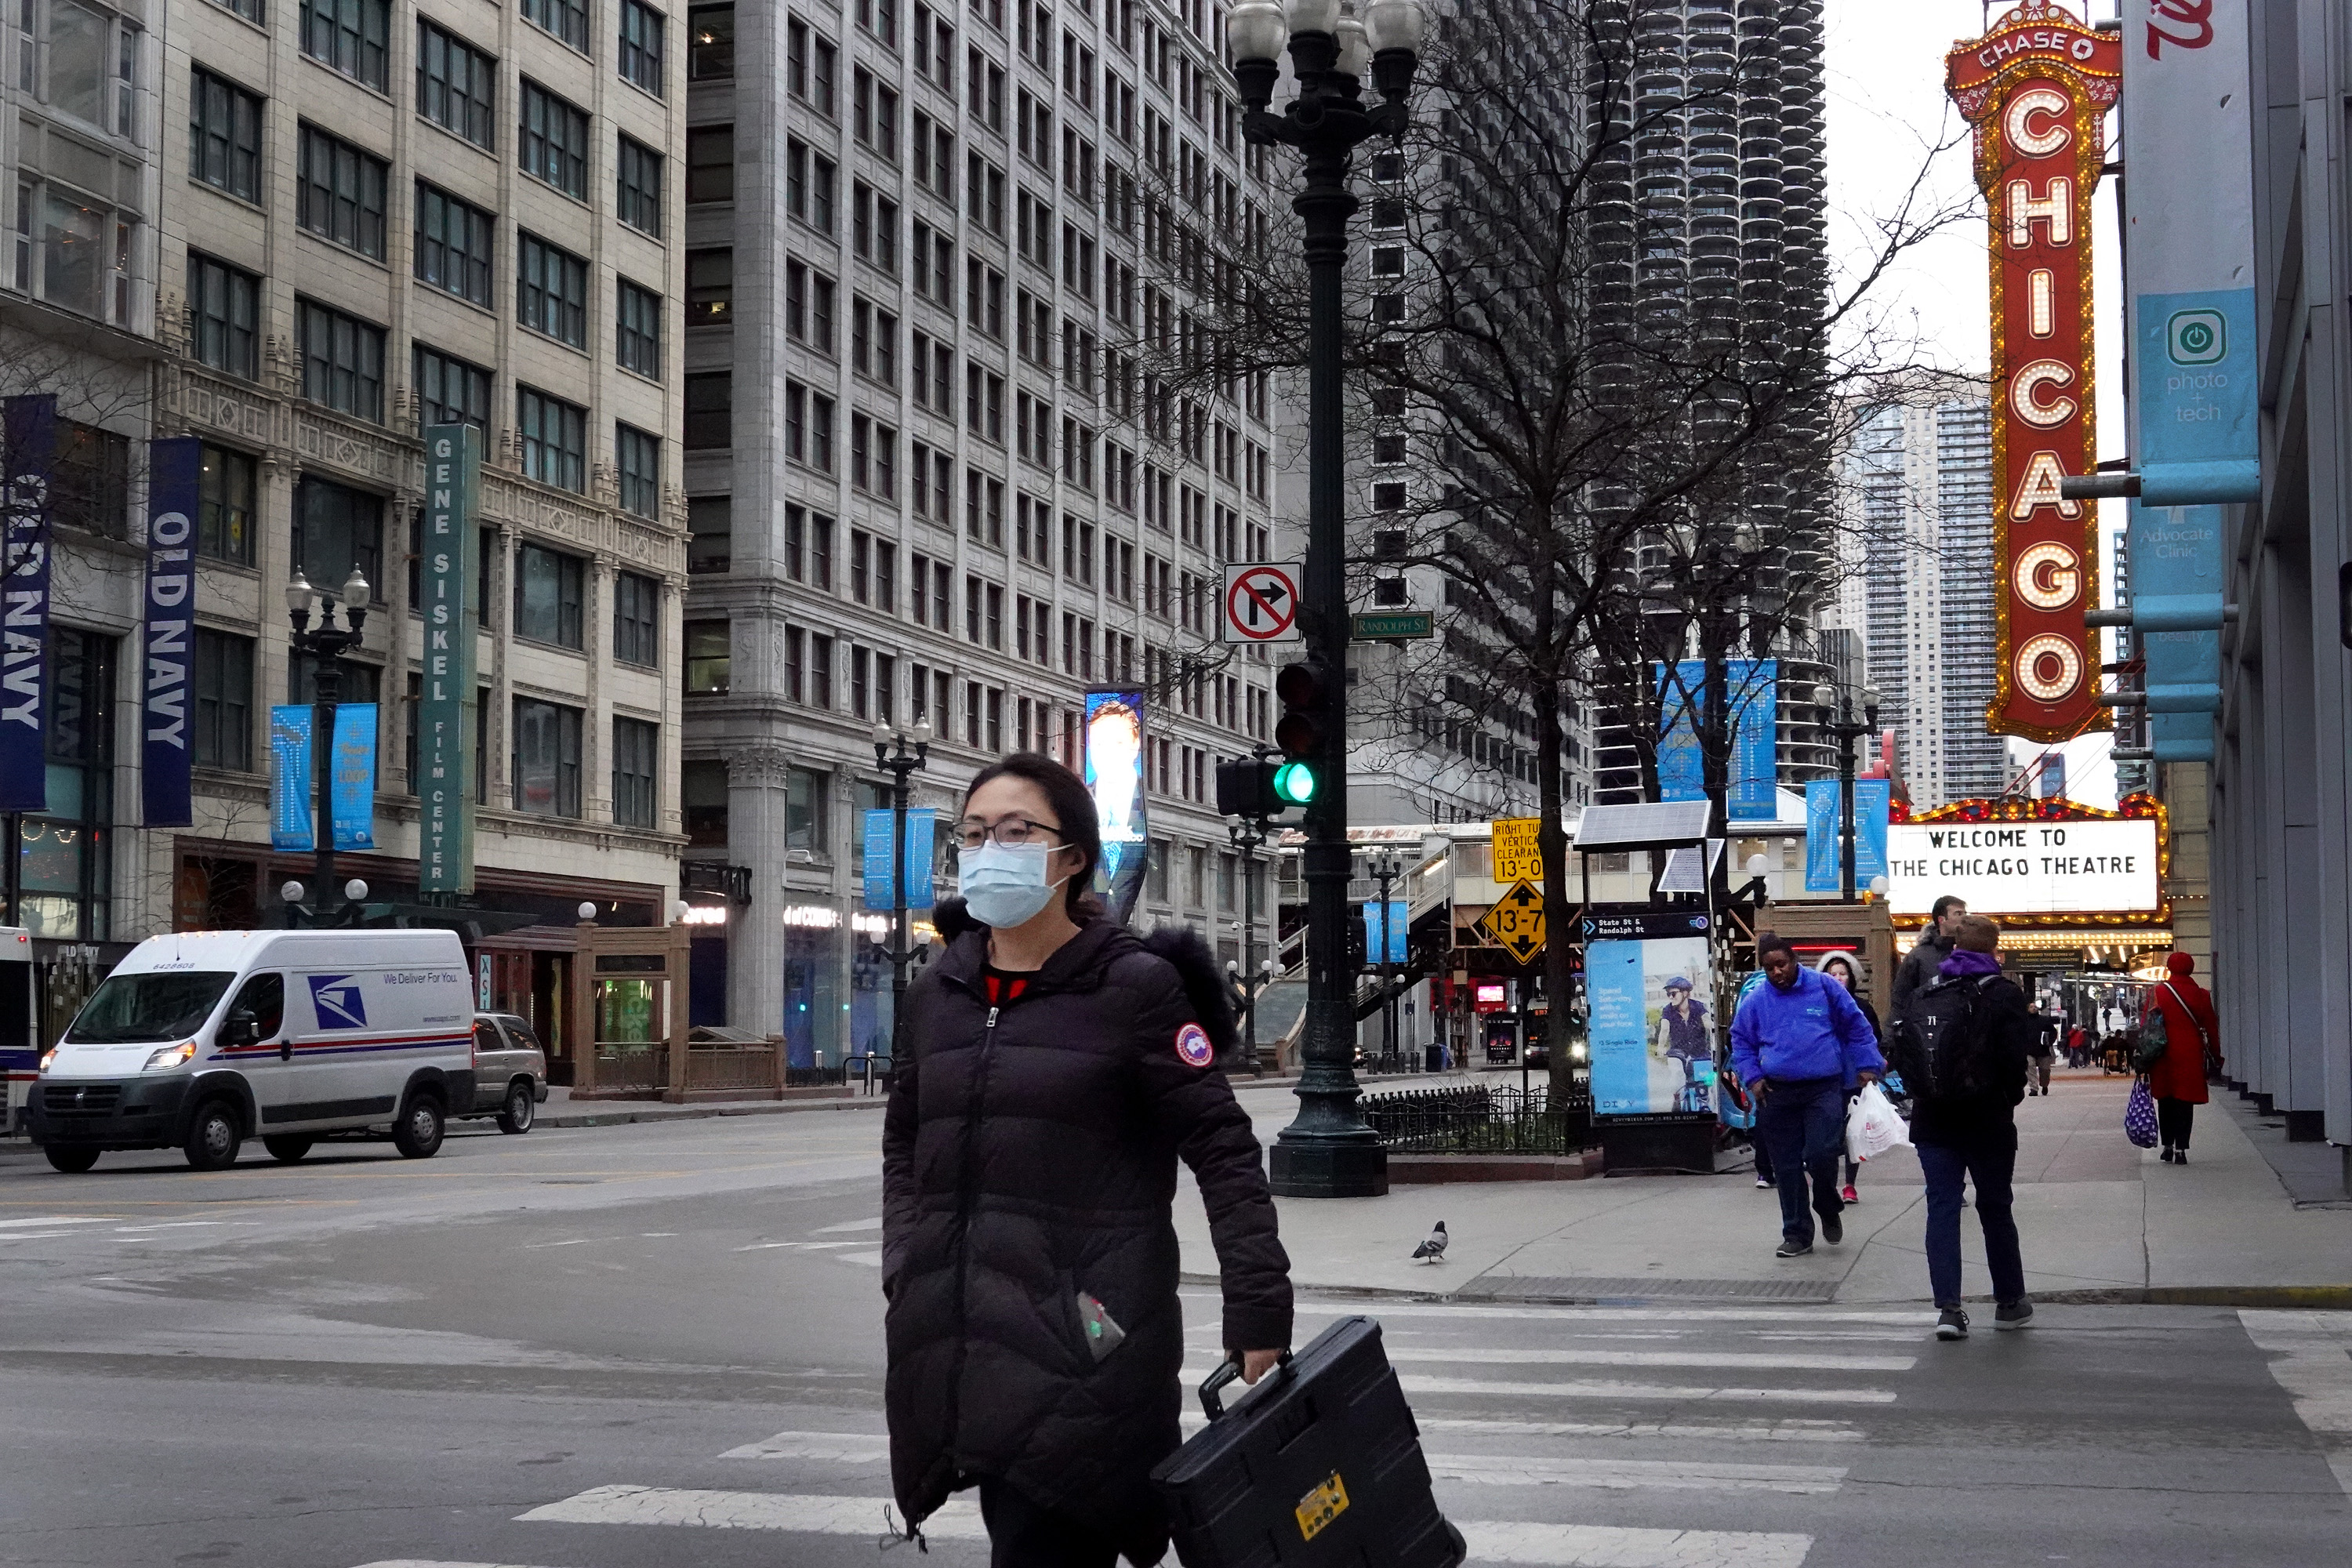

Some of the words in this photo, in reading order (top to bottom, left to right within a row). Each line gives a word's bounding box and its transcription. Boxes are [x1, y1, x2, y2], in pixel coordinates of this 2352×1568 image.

[1979, 31, 2067, 68] CHASE
[2167, 371, 2228, 394] photo
[2004, 88, 2085, 705] CHICAGO
[2176, 403, 2221, 423] tech
[434, 438, 452, 535] GENE
[8, 474, 47, 576] OLD
[2140, 528, 2214, 543] Advocate
[151, 511, 190, 607] OLD
[2156, 544, 2198, 559] Clinic
[433, 554, 450, 701] SISKEL
[2158, 631, 2205, 644] beauty
[2, 590, 43, 731] NAVY
[147, 619, 187, 750] NAVY
[433, 721, 445, 779] FILM
[432, 790, 444, 879] CENTER
[1495, 824, 1522, 835] RIGHT
[1527, 823, 1541, 833] TU
[1929, 829, 2027, 849] WELCOME
[2041, 828, 2067, 847] TO
[1502, 836, 1538, 847] VERTICA
[1497, 848, 1541, 859] CLEARAN
[1890, 859, 1927, 877] THE
[1940, 858, 2029, 877] CHICAGO
[2041, 856, 2136, 875] THEATRE
[153, 962, 196, 971] 6428608
[383, 974, 397, 984] We
[398, 973, 426, 984] Deliver
[427, 972, 440, 982] For
[441, 972, 458, 982] You.
